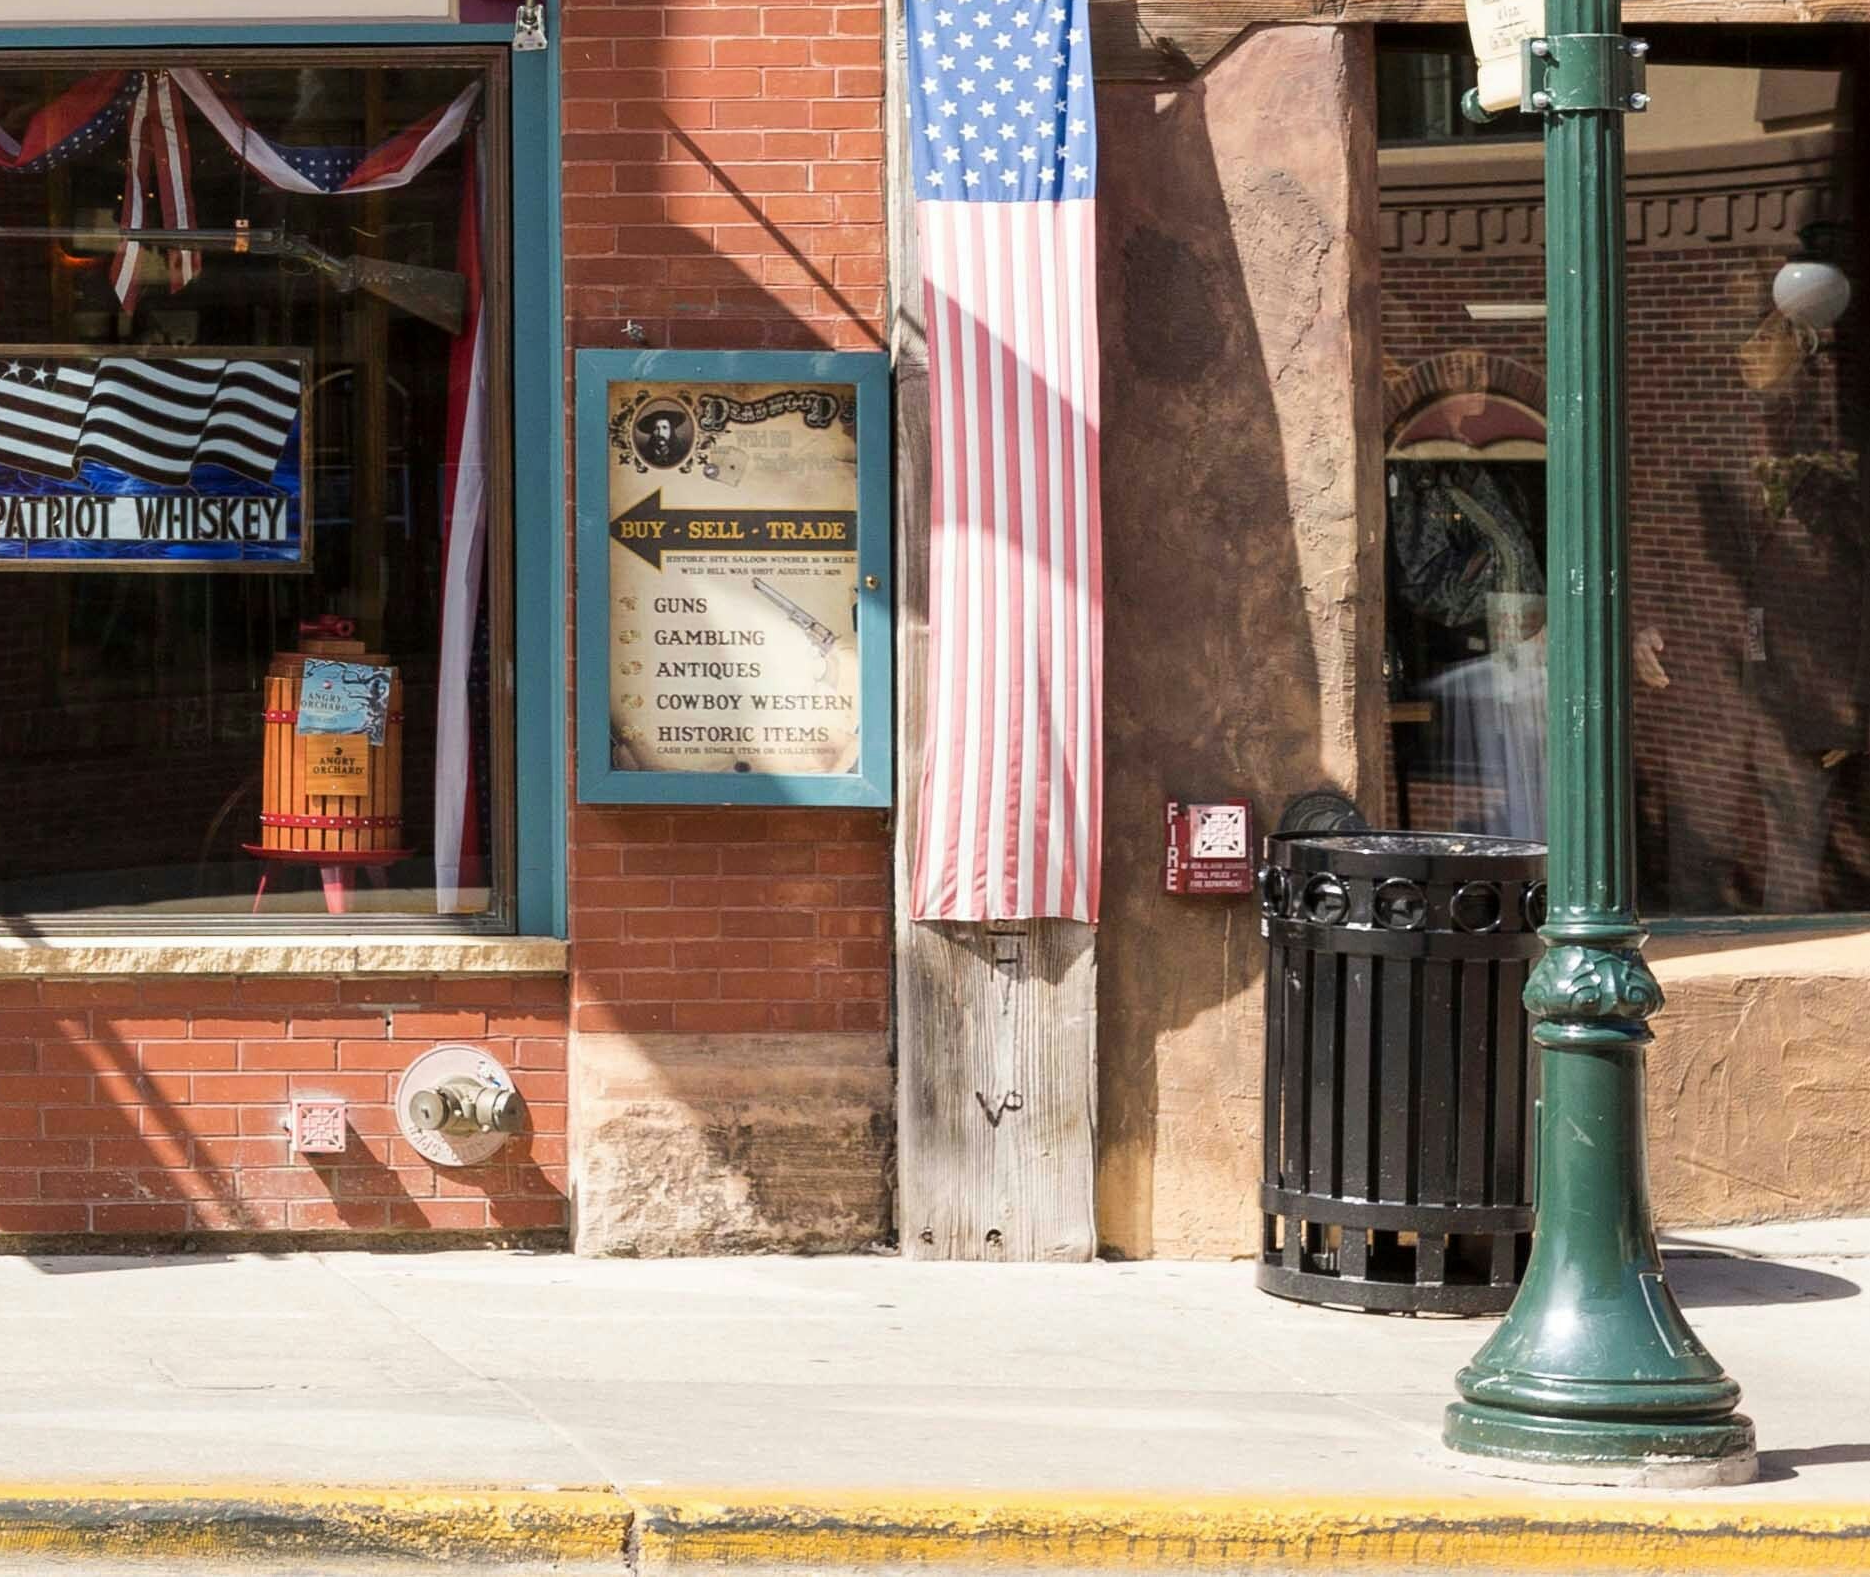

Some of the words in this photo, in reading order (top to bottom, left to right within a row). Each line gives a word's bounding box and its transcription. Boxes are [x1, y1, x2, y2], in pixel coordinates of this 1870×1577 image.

[134, 496, 286, 540] WHISKEY
[620, 520, 667, 540] BUY
[688, 520, 745, 540] SELL
[766, 521, 846, 541] TRADE
[666, 555, 707, 564] HISTORIC
[710, 555, 729, 564] SITE
[732, 555, 767, 564] SALOON
[771, 555, 808, 564] NUMBER
[823, 555, 856, 564] WHERE
[681, 567, 703, 575] WILD
[707, 567, 726, 575] BILL
[730, 567, 749, 575] WAS
[752, 567, 774, 575] SHOT
[777, 567, 810, 575] AUGUST
[654, 597, 708, 614] GUNS
[654, 629, 766, 646] GAMBLING
[656, 662, 762, 680] ANTIQUES
[308, 693, 342, 703] ANGRY
[656, 693, 743, 710] COWBOY
[750, 694, 854, 710] WESTERN
[301, 701, 349, 712] ORCHARD
[658, 726, 755, 742] HISTORIC
[763, 726, 830, 742] ITEMS
[656, 746, 682, 755] CASH
[684, 747, 702, 755] FOR
[704, 746, 735, 755] SINGLE
[738, 746, 761, 755] ITEM
[763, 747, 776, 755] OR
[320, 757, 356, 766] ANGRY
[313, 766, 362, 775] ORCHARD
[1166, 802, 1179, 891] FIRE
